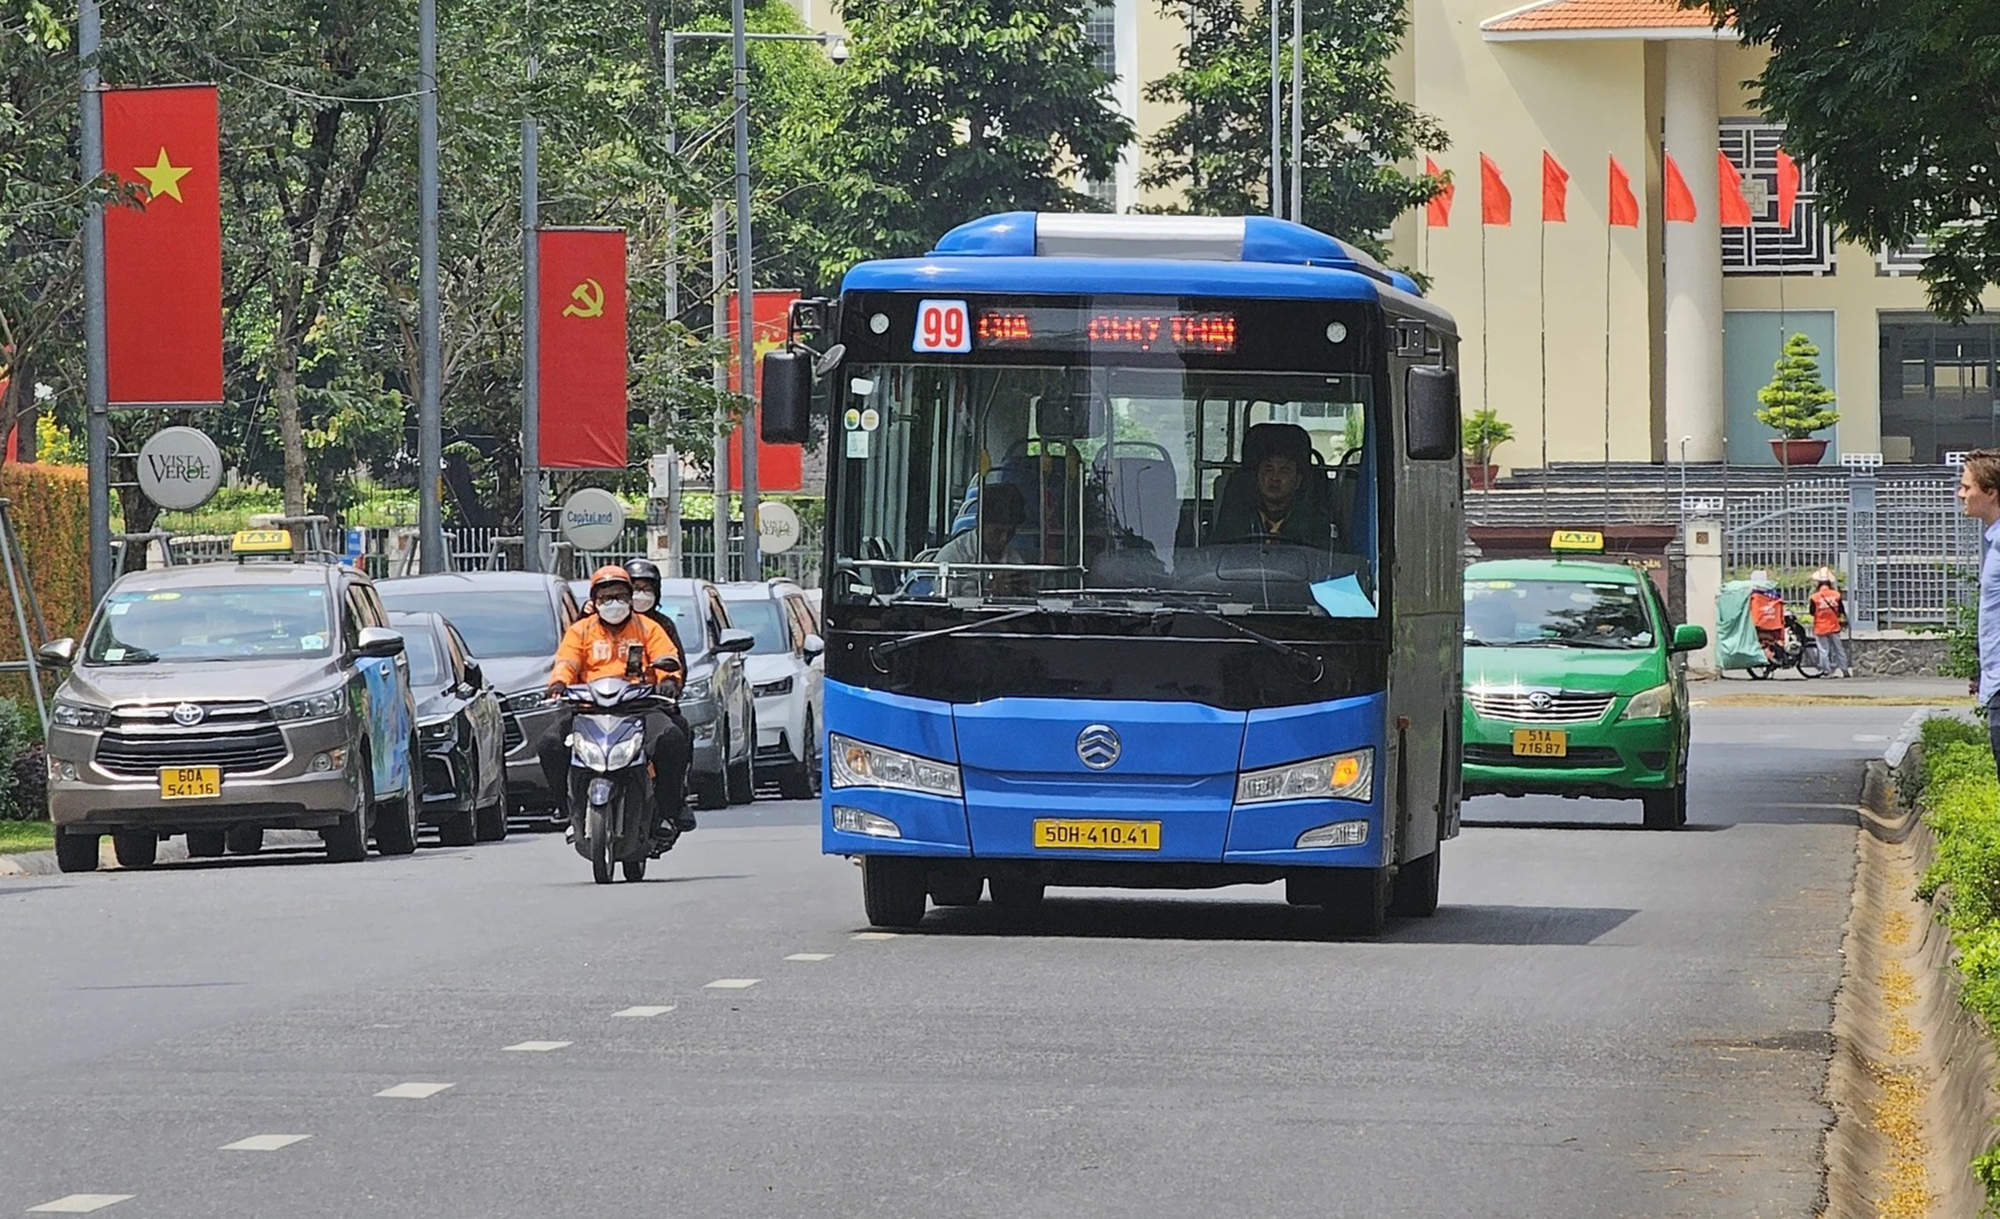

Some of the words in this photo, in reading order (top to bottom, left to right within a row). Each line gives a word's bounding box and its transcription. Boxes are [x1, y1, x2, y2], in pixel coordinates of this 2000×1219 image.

[924, 308, 963, 347] 99
[147, 454, 211, 484] VERDE
[159, 454, 204, 469] VISTA
[567, 509, 612, 525] CapitaLand
[241, 532, 283, 544] TAXI
[1529, 730, 1552, 742] 51A
[1519, 742, 1561, 754] 716.87
[178, 769, 203, 782] 60A
[168, 782, 214, 797] 541.16
[1045, 826, 1149, 844] 50H-410.41
